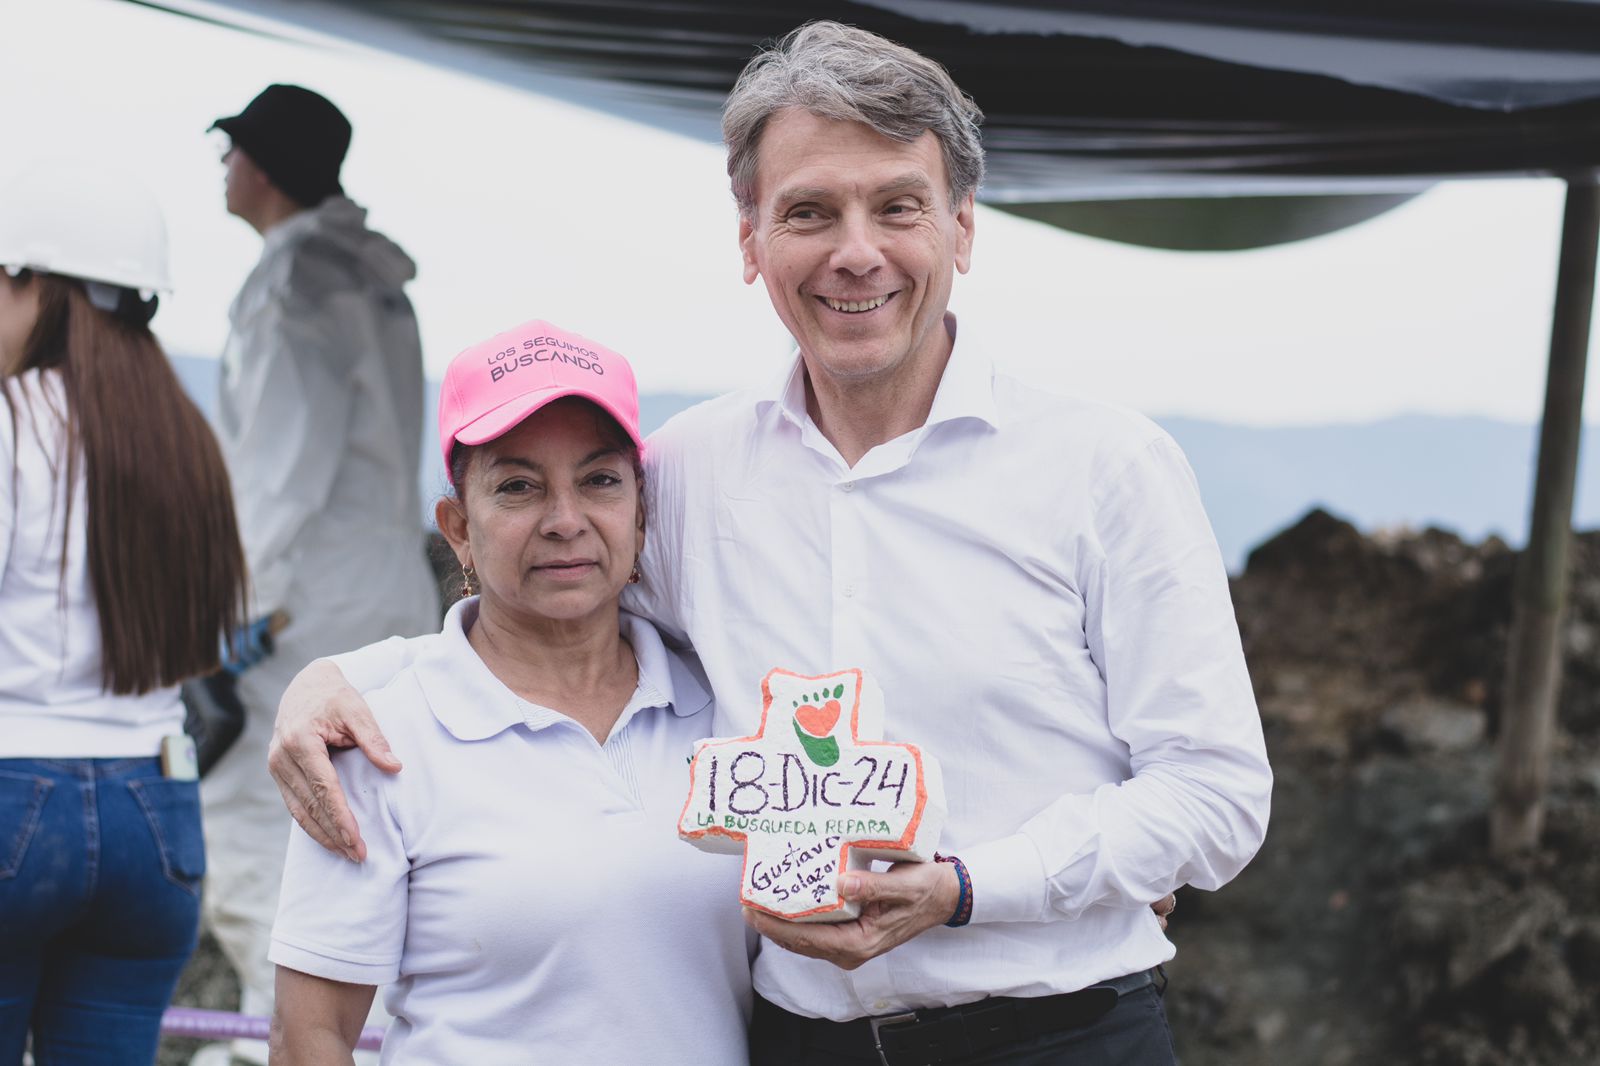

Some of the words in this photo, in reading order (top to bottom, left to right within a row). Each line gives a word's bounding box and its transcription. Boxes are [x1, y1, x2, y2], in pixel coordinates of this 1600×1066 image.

[488, 347, 516, 365] LOS
[523, 336, 599, 361] SEGUIMOS
[490, 349, 604, 382] BUSCANDO
[697, 812, 715, 826] LA
[825, 818, 890, 835] REPARA
